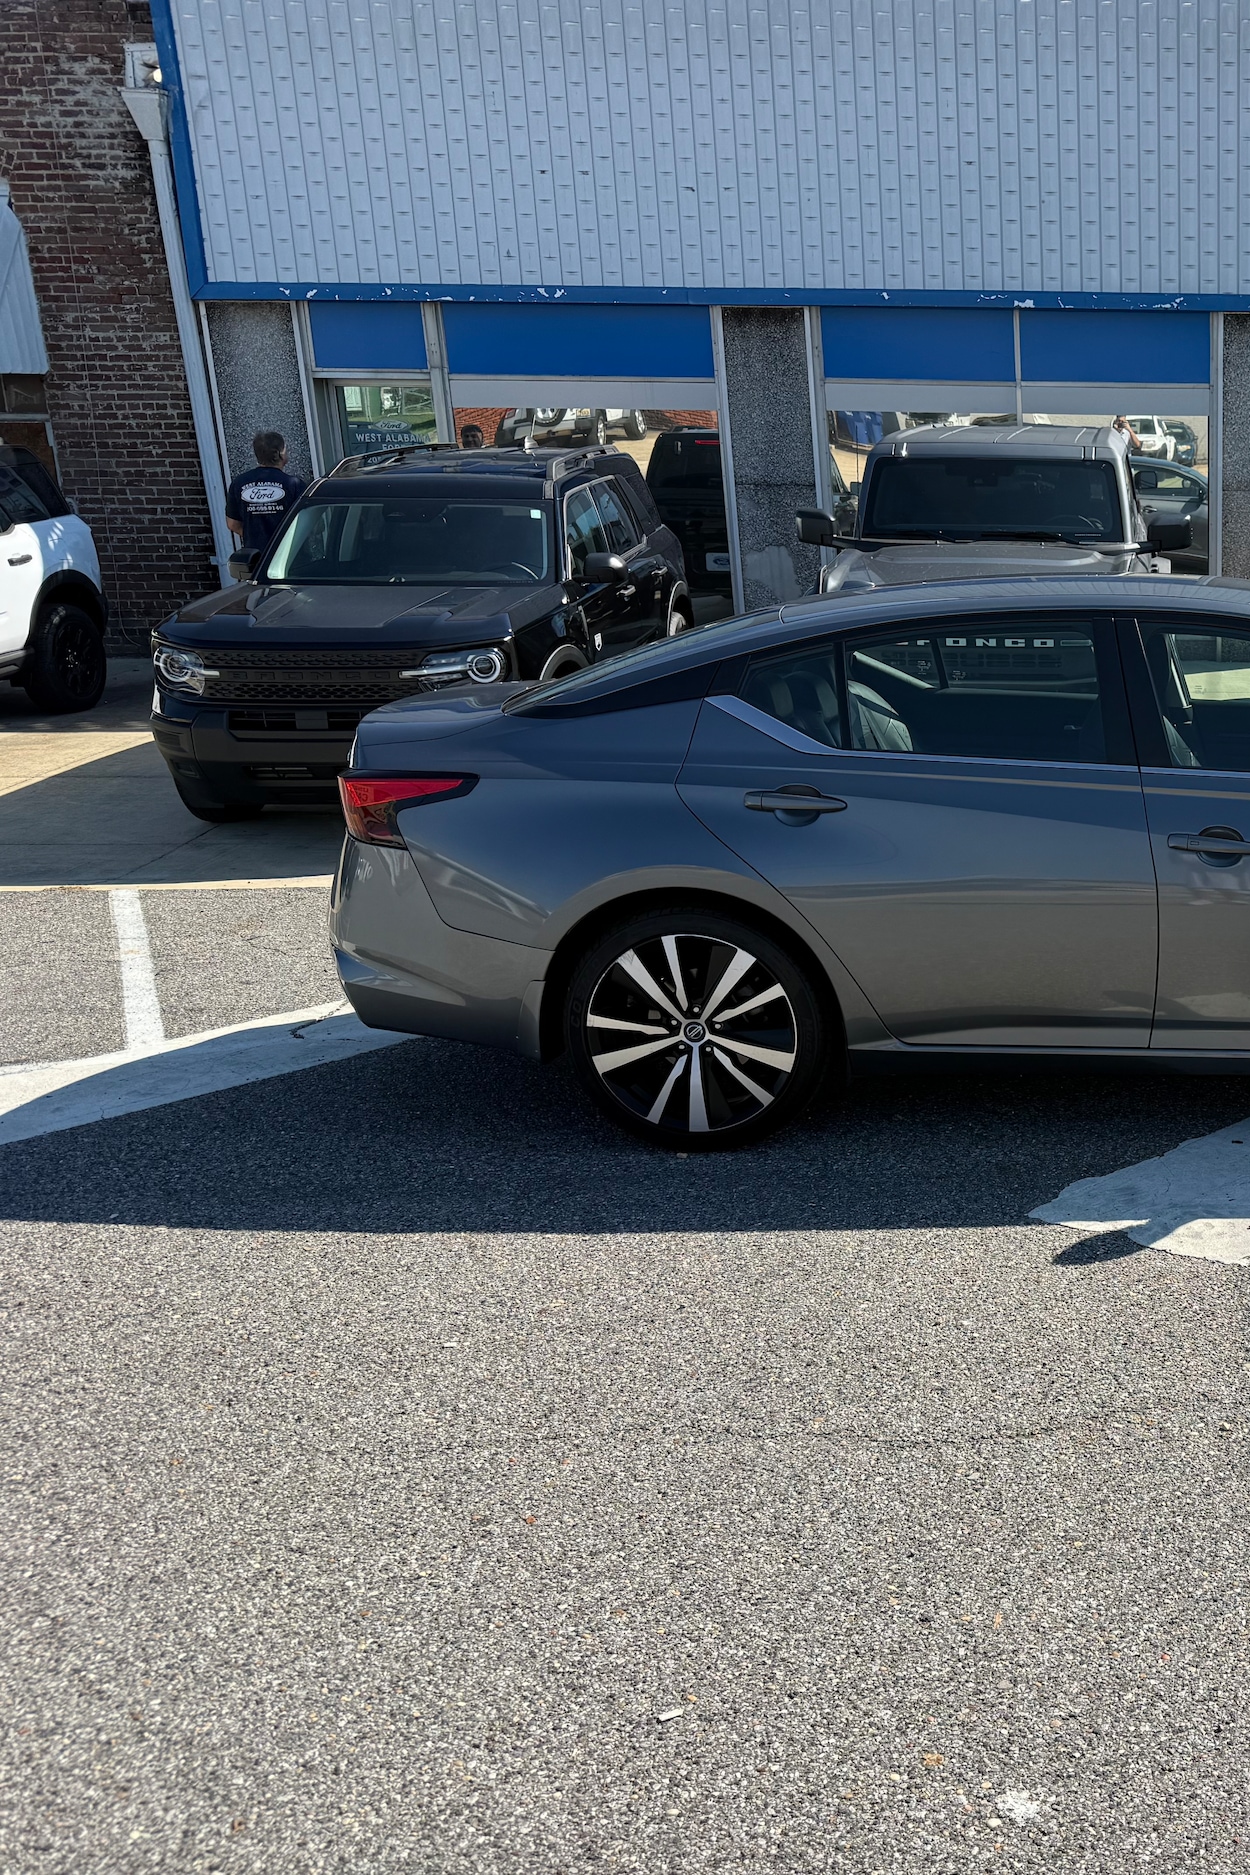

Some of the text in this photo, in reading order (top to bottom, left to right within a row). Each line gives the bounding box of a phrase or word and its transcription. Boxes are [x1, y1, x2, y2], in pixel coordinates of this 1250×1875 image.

[380, 421, 403, 429] Ford
[355, 433, 432, 443] WEST ALABAMA
[241, 482, 256, 491] WEST
[249, 488, 275, 500] Ford
[896, 637, 1055, 648] ONCO
[227, 670, 391, 681] BRONCO
